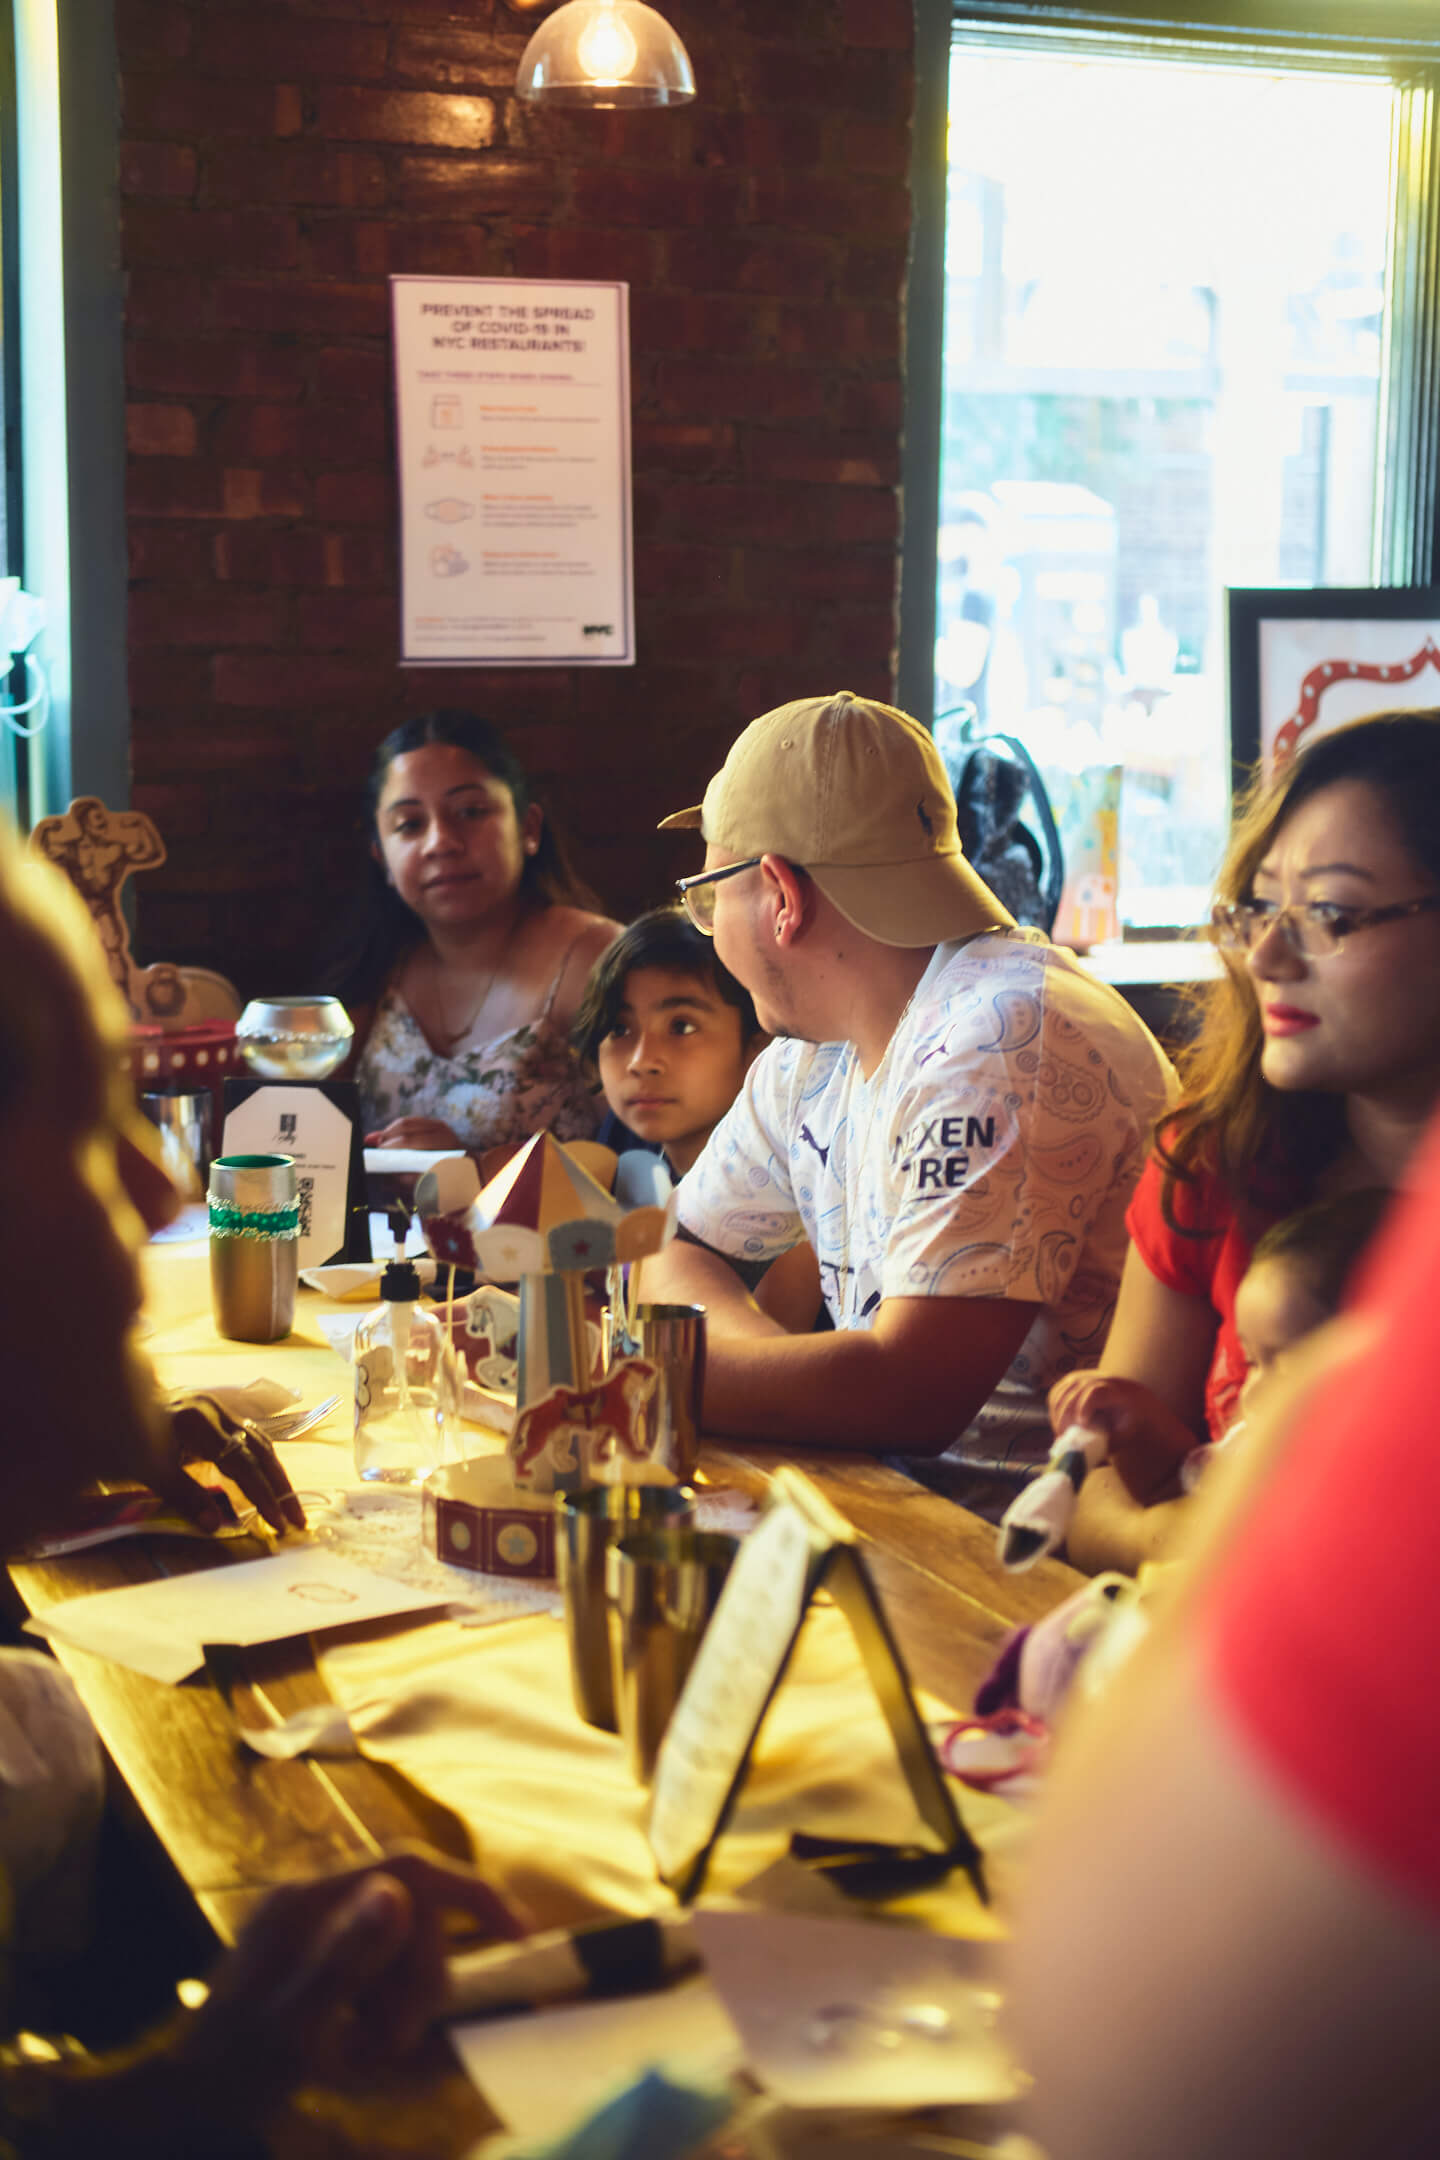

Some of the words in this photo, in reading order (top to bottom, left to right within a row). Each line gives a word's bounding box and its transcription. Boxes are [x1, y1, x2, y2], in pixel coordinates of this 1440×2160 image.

[421, 303, 493, 317] PREVENT
[499, 306, 526, 318] THE
[533, 306, 595, 320] SPREAD
[452, 321, 472, 333] OF
[555, 323, 570, 335] IN
[432, 336, 465, 350] NYC
